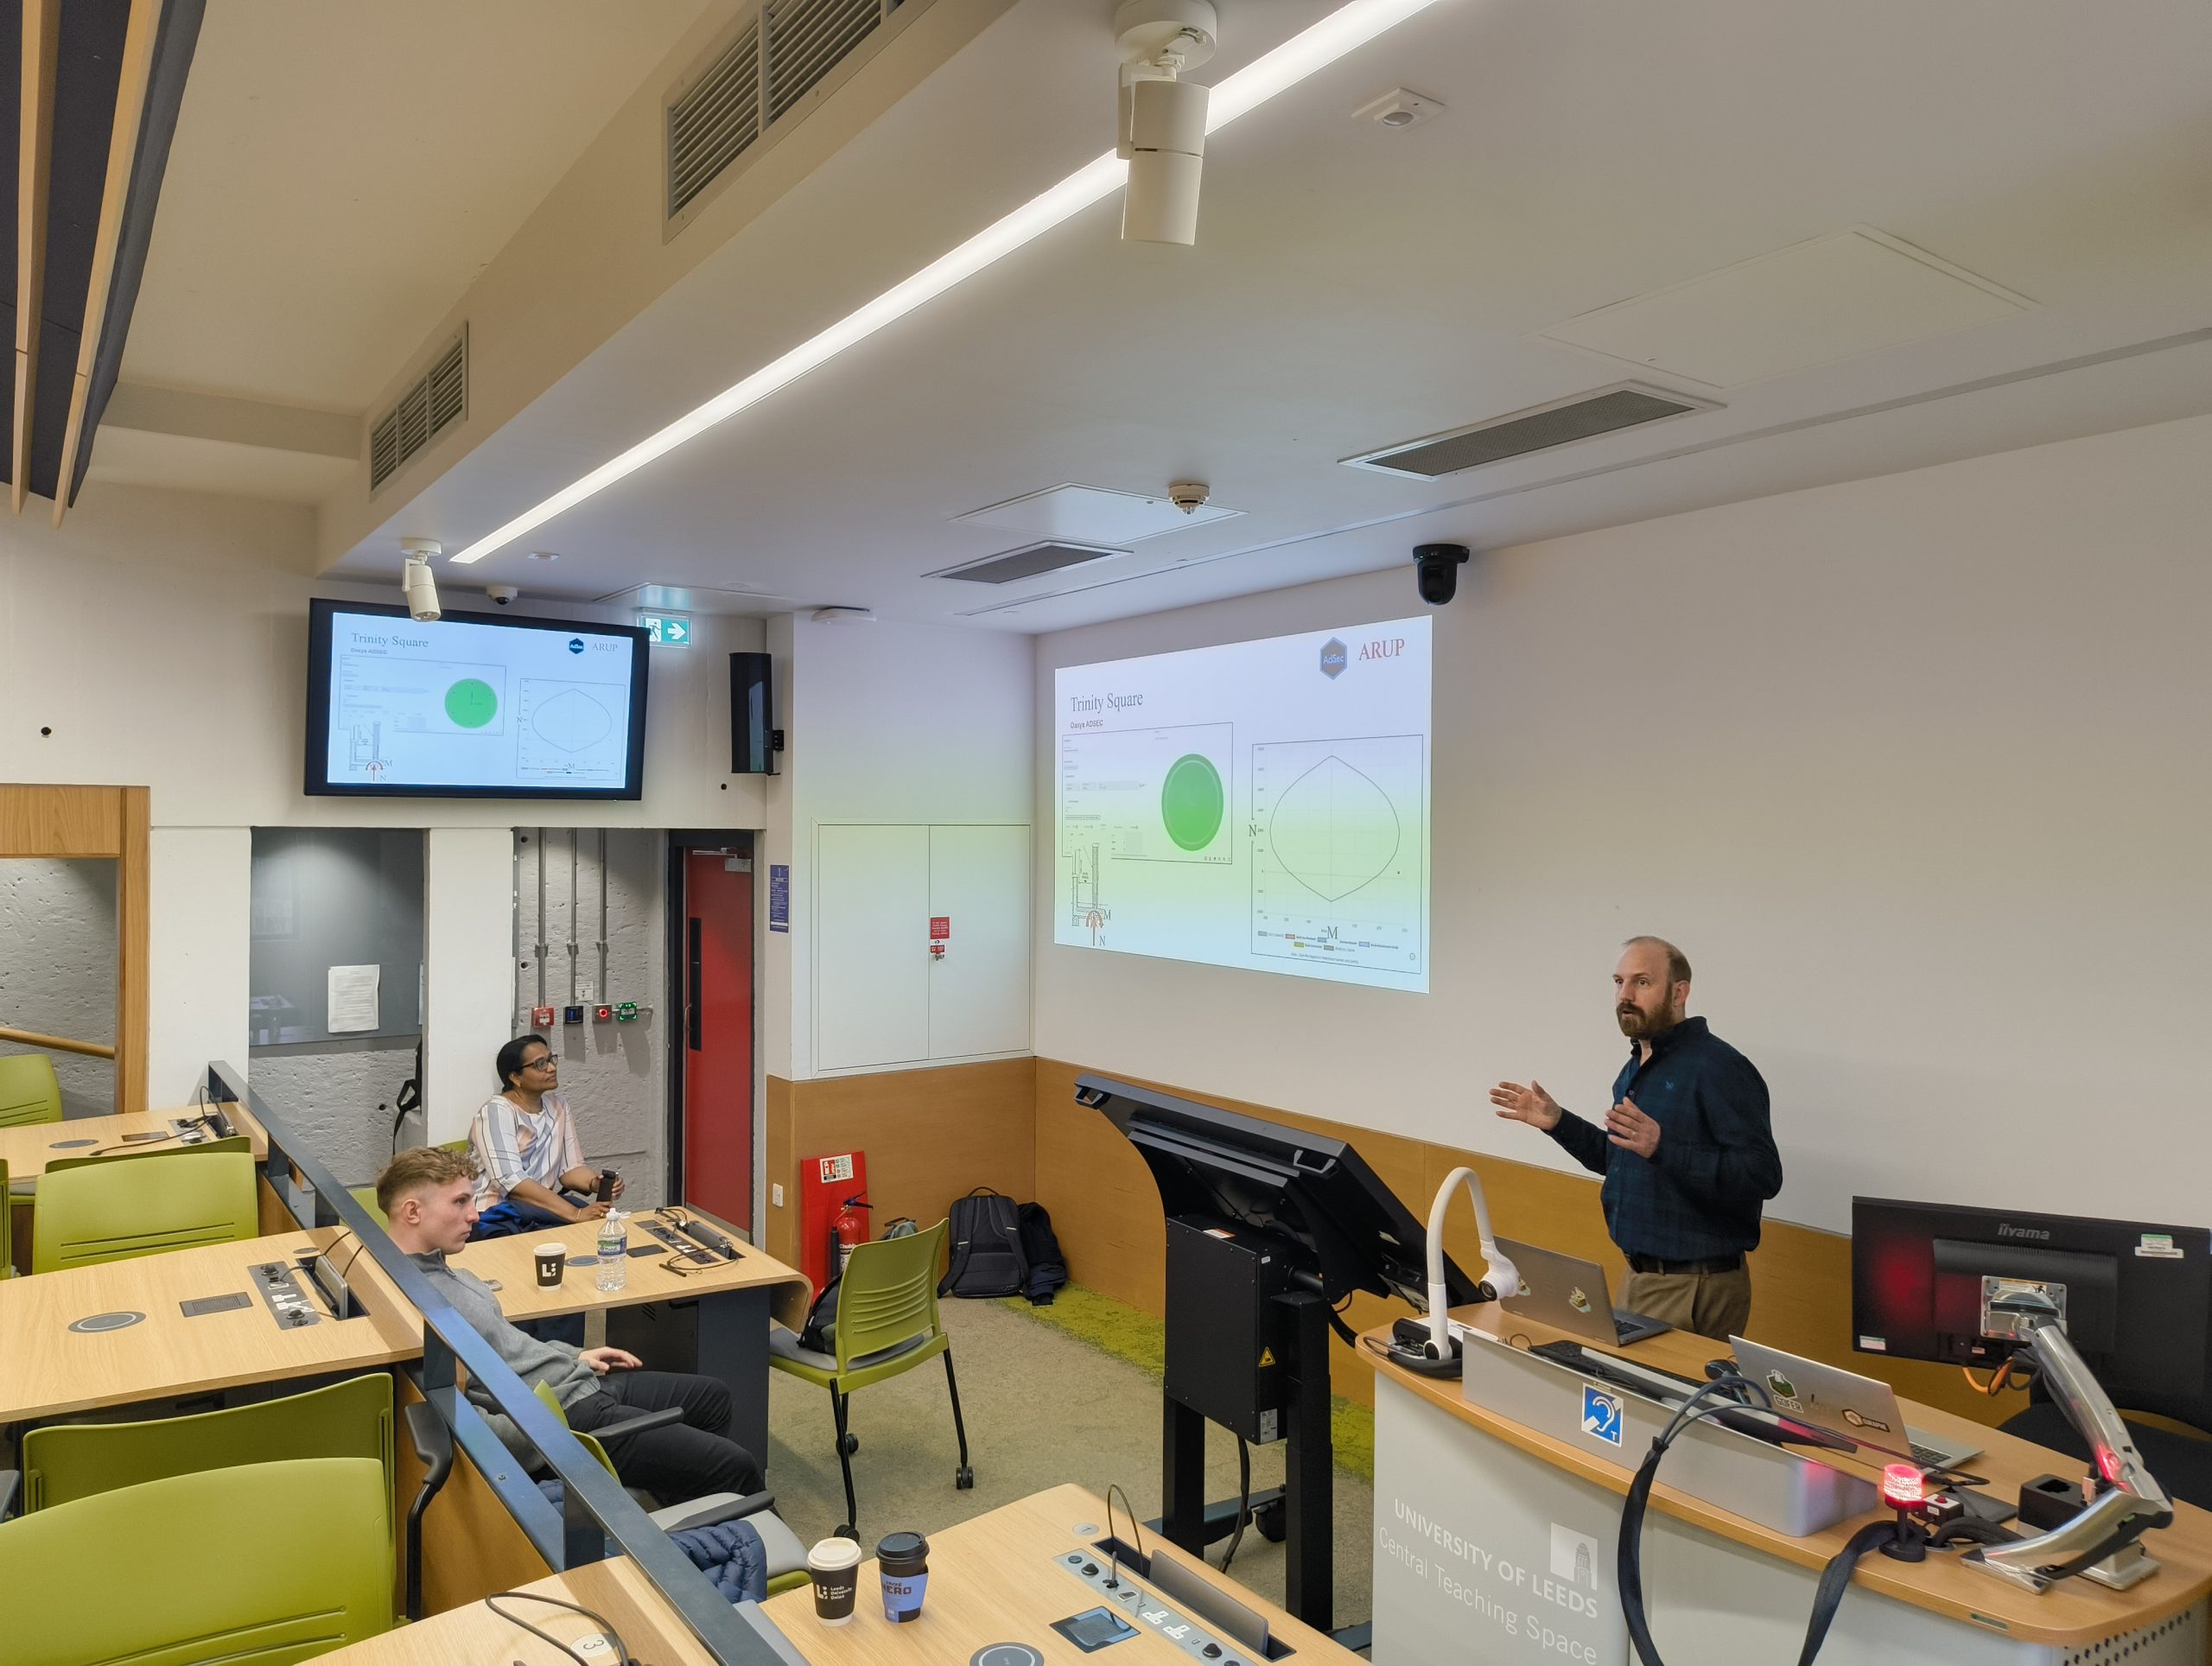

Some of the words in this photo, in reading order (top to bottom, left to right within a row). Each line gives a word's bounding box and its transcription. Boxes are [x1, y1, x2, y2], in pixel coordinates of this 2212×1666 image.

[350, 632, 388, 646] Trinity
[392, 635, 429, 648] Square
[592, 643, 618, 652] ARUP
[1359, 639, 1405, 660] ARUP
[1323, 654, 1344, 664] AdSec
[1071, 695, 1103, 714] Trinity
[1107, 692, 1144, 712] Square
[1249, 824, 1257, 837] N
[1103, 909, 1112, 920] M
[1327, 925, 1338, 939] M
[1099, 935, 1106, 946] N
[1998, 1223, 2050, 1240] iiyama
[1611, 1430, 1618, 1441] T
[1394, 1497, 1493, 1571] UNIVERSITY
[1497, 1561, 1525, 1587] OF
[1532, 1574, 1598, 1618] LEEDS
[1379, 1527, 1428, 1579] Central
[1434, 1563, 1518, 1635] Teaching
[1526, 1614, 1597, 1665] Space
